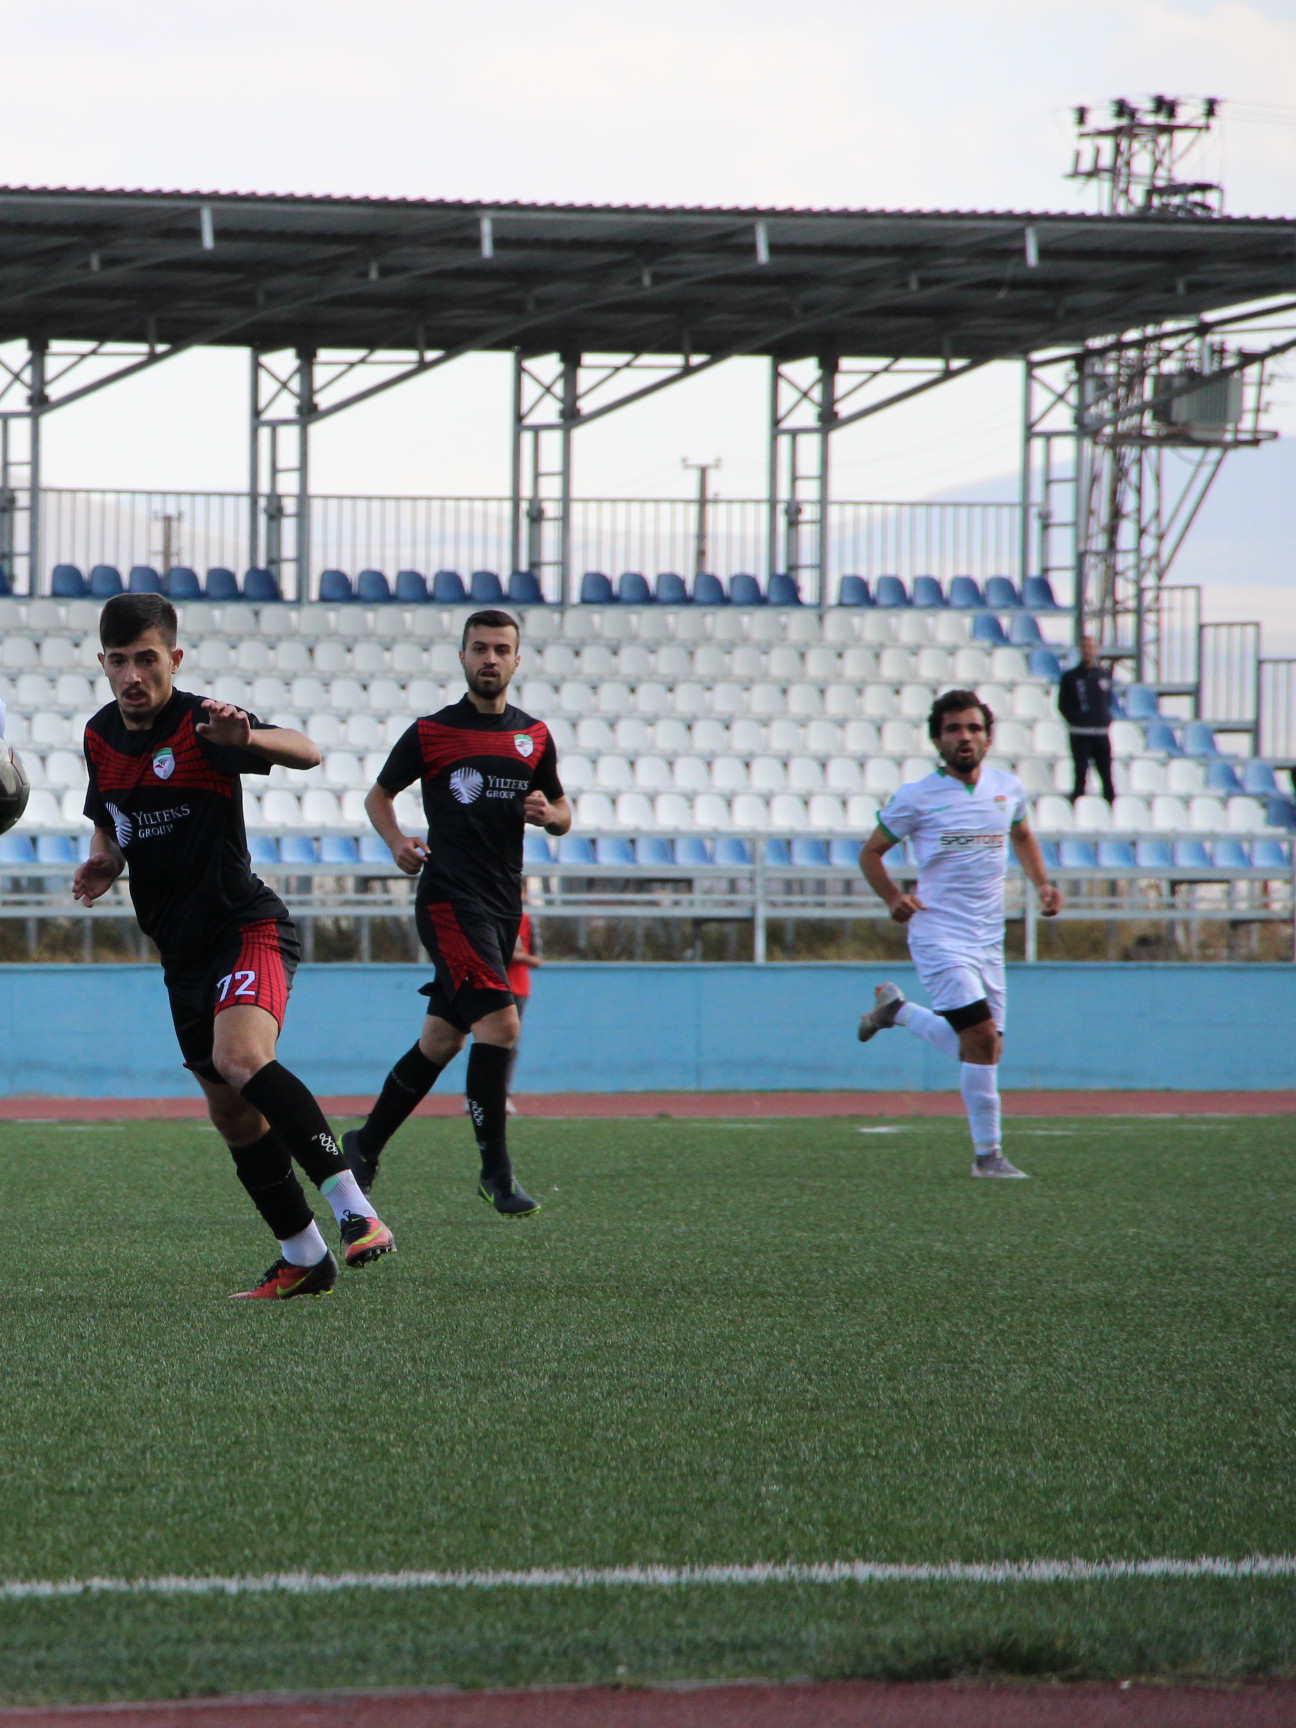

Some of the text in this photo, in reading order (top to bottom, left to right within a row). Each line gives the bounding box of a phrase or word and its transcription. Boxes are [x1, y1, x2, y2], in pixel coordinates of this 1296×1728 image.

[487, 775, 529, 790] YILTEKS
[486, 789, 516, 799] GROUP
[132, 803, 191, 826] YILTEKS
[138, 823, 173, 839] GROUP
[216, 970, 256, 1002] 72
